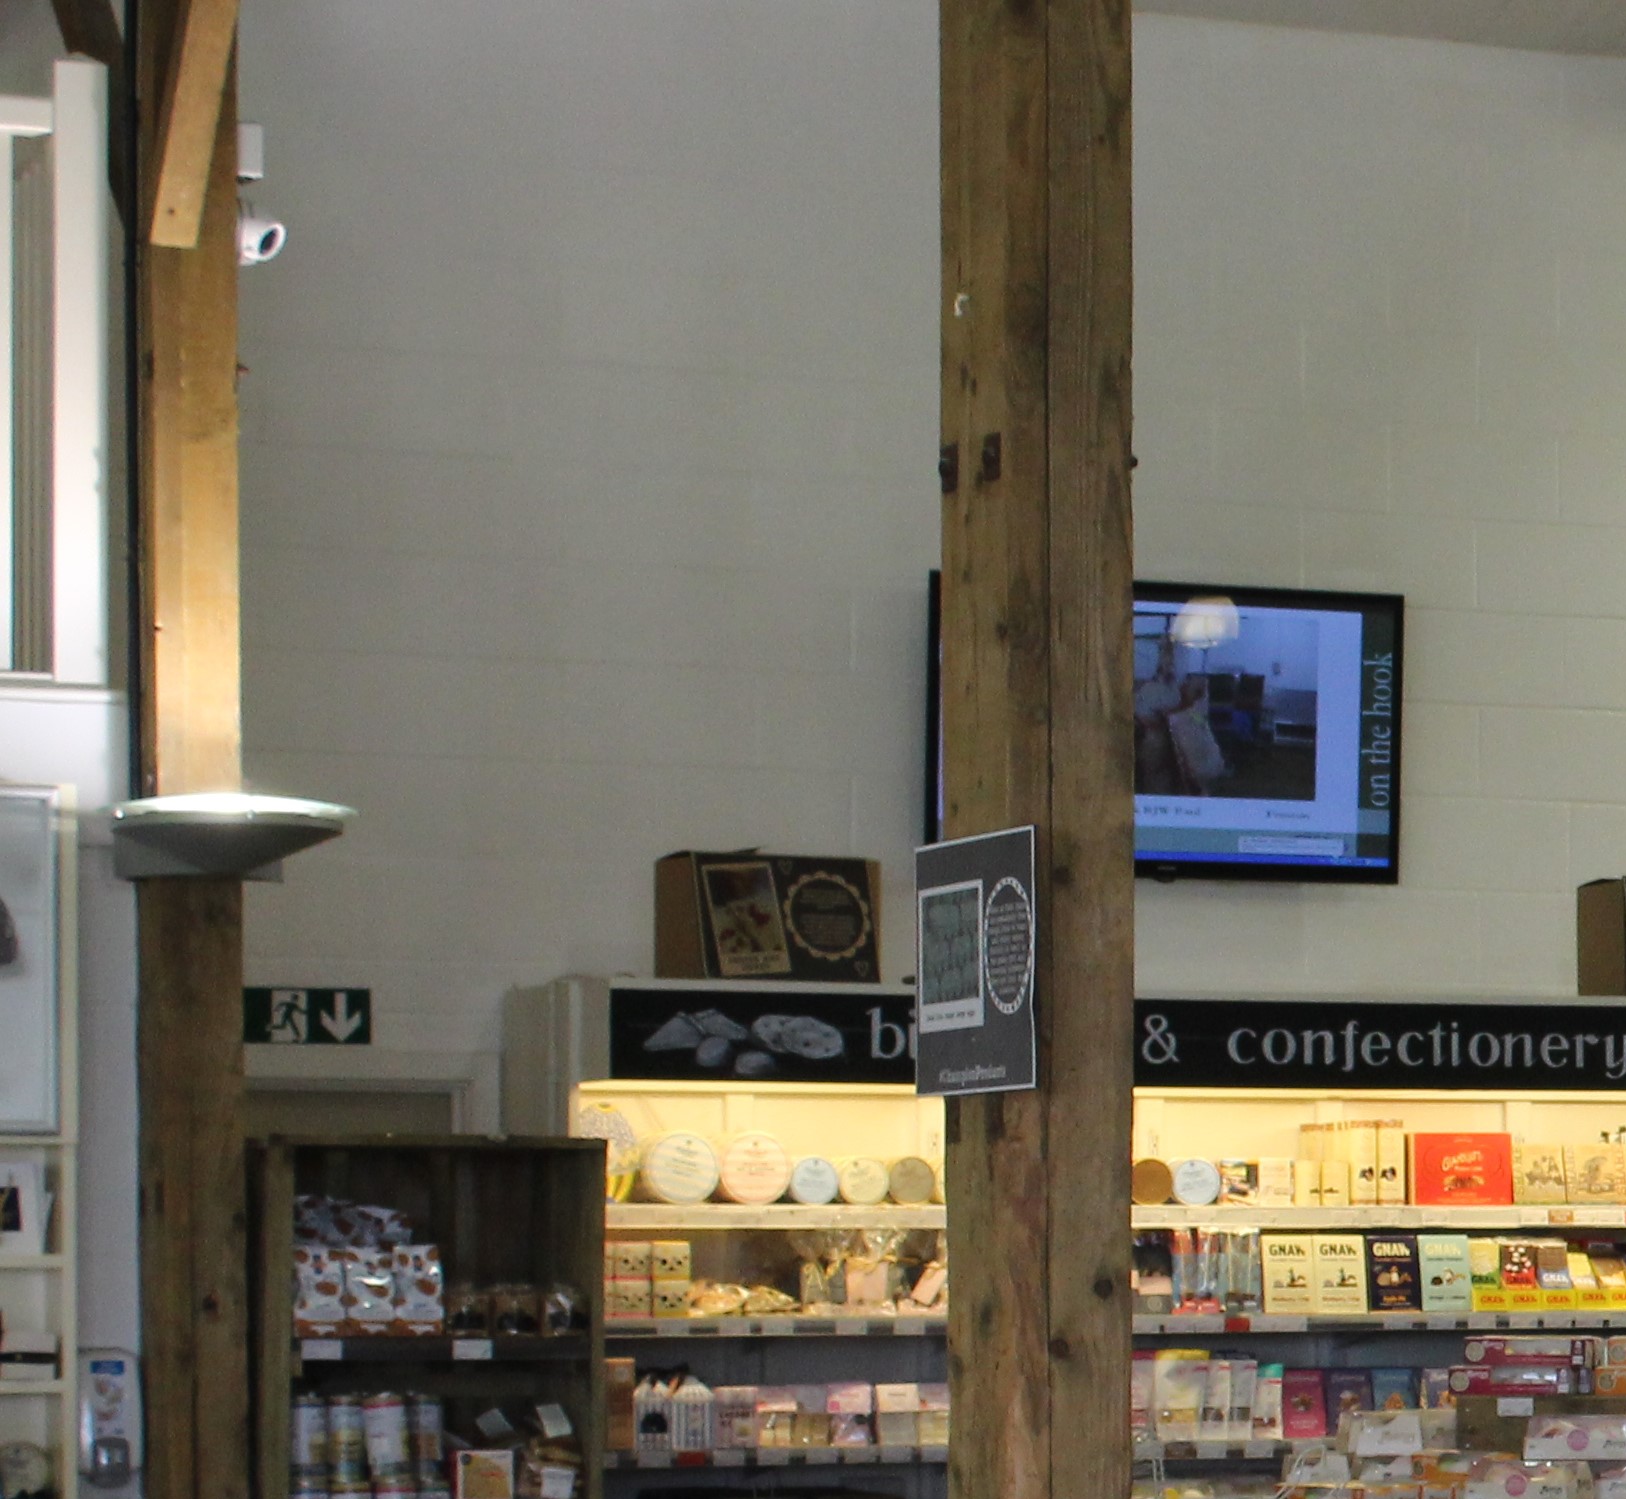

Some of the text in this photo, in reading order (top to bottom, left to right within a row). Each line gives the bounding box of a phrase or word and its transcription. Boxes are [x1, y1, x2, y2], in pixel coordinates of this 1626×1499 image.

[1361, 651, 1393, 807] on the hook
[1141, 1013, 1182, 1064] &
